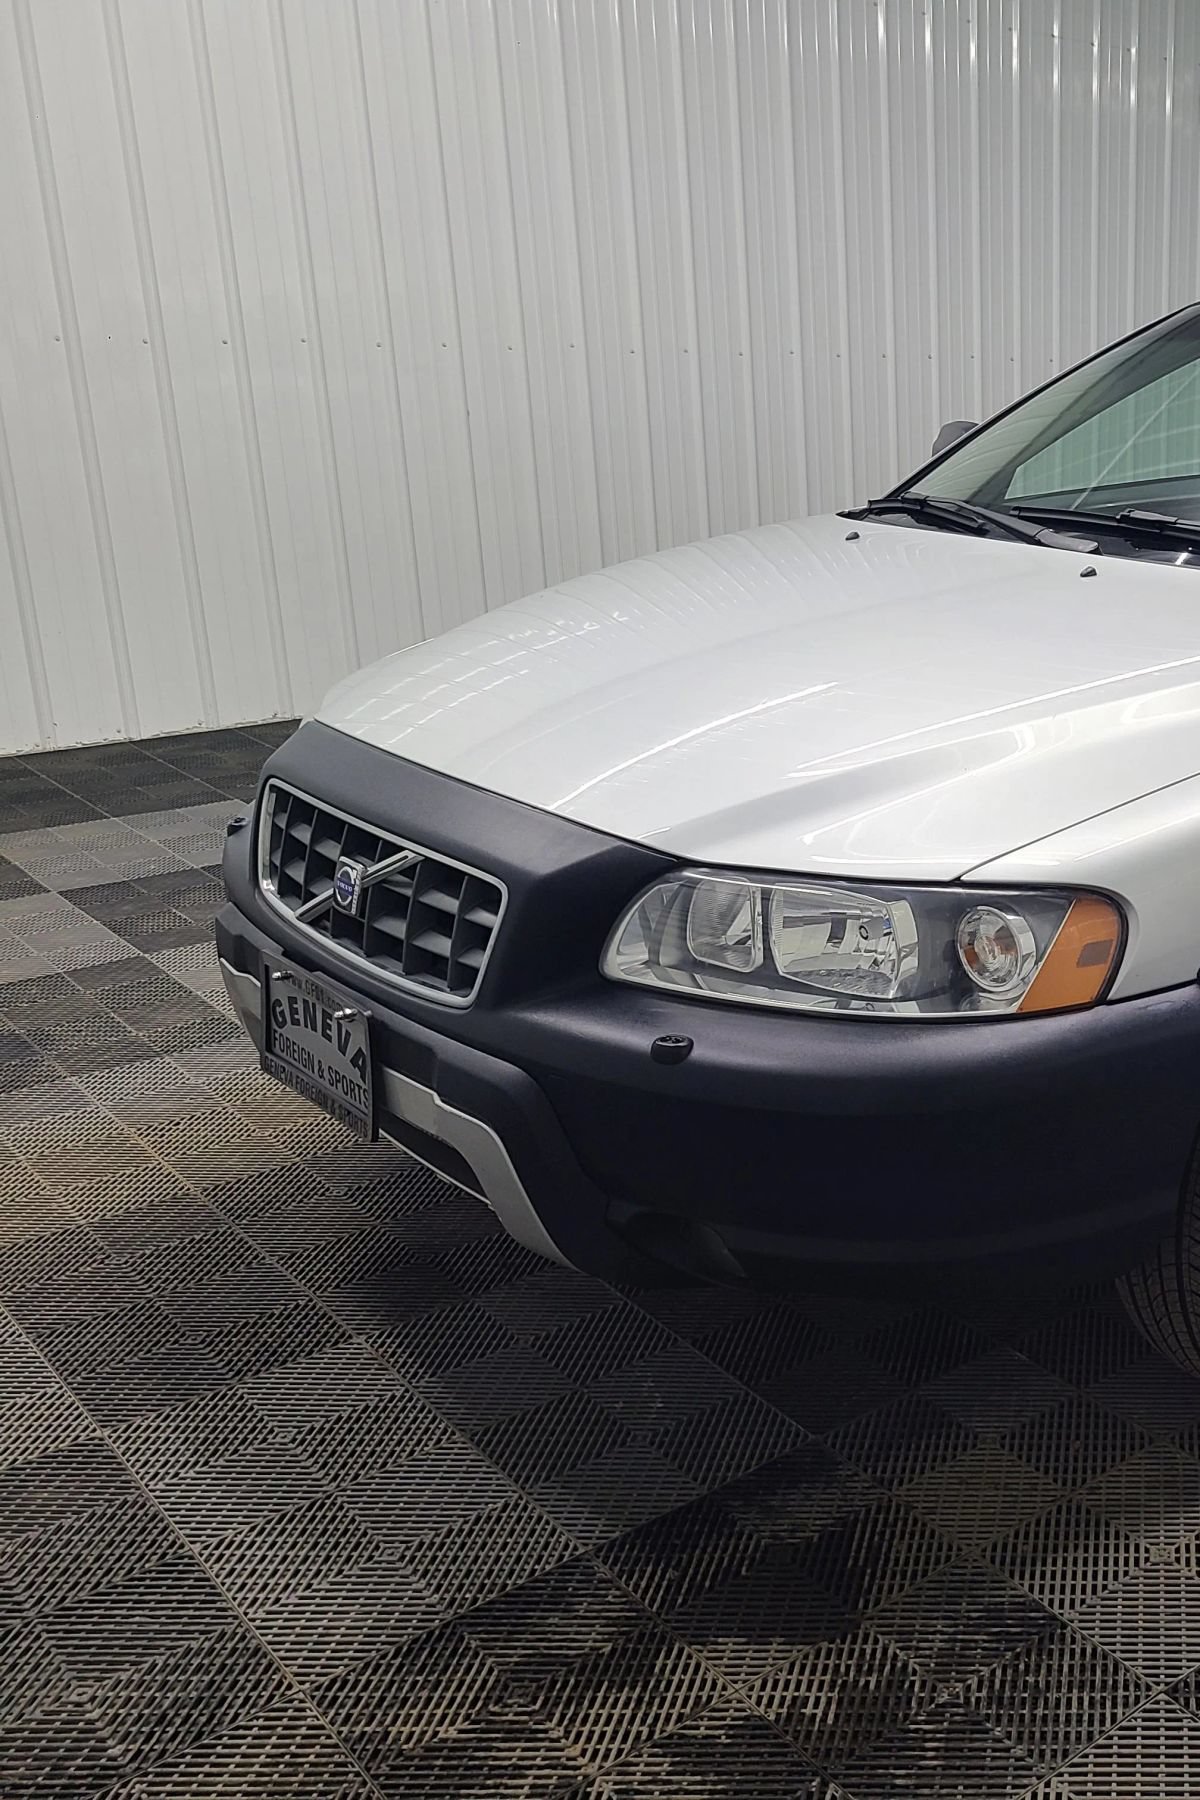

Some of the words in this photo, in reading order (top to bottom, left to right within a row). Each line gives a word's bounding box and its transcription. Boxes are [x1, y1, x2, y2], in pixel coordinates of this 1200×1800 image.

[271, 995, 367, 1083] GENEVA
[273, 1028, 316, 1074] FOREIGN
[317, 1059, 326, 1081] &
[327, 1065, 369, 1110] SPORTS
[264, 1054, 294, 1089] GENEVA
[295, 1074, 329, 1112] FOREIGN
[338, 1102, 369, 1140] SPORTS
